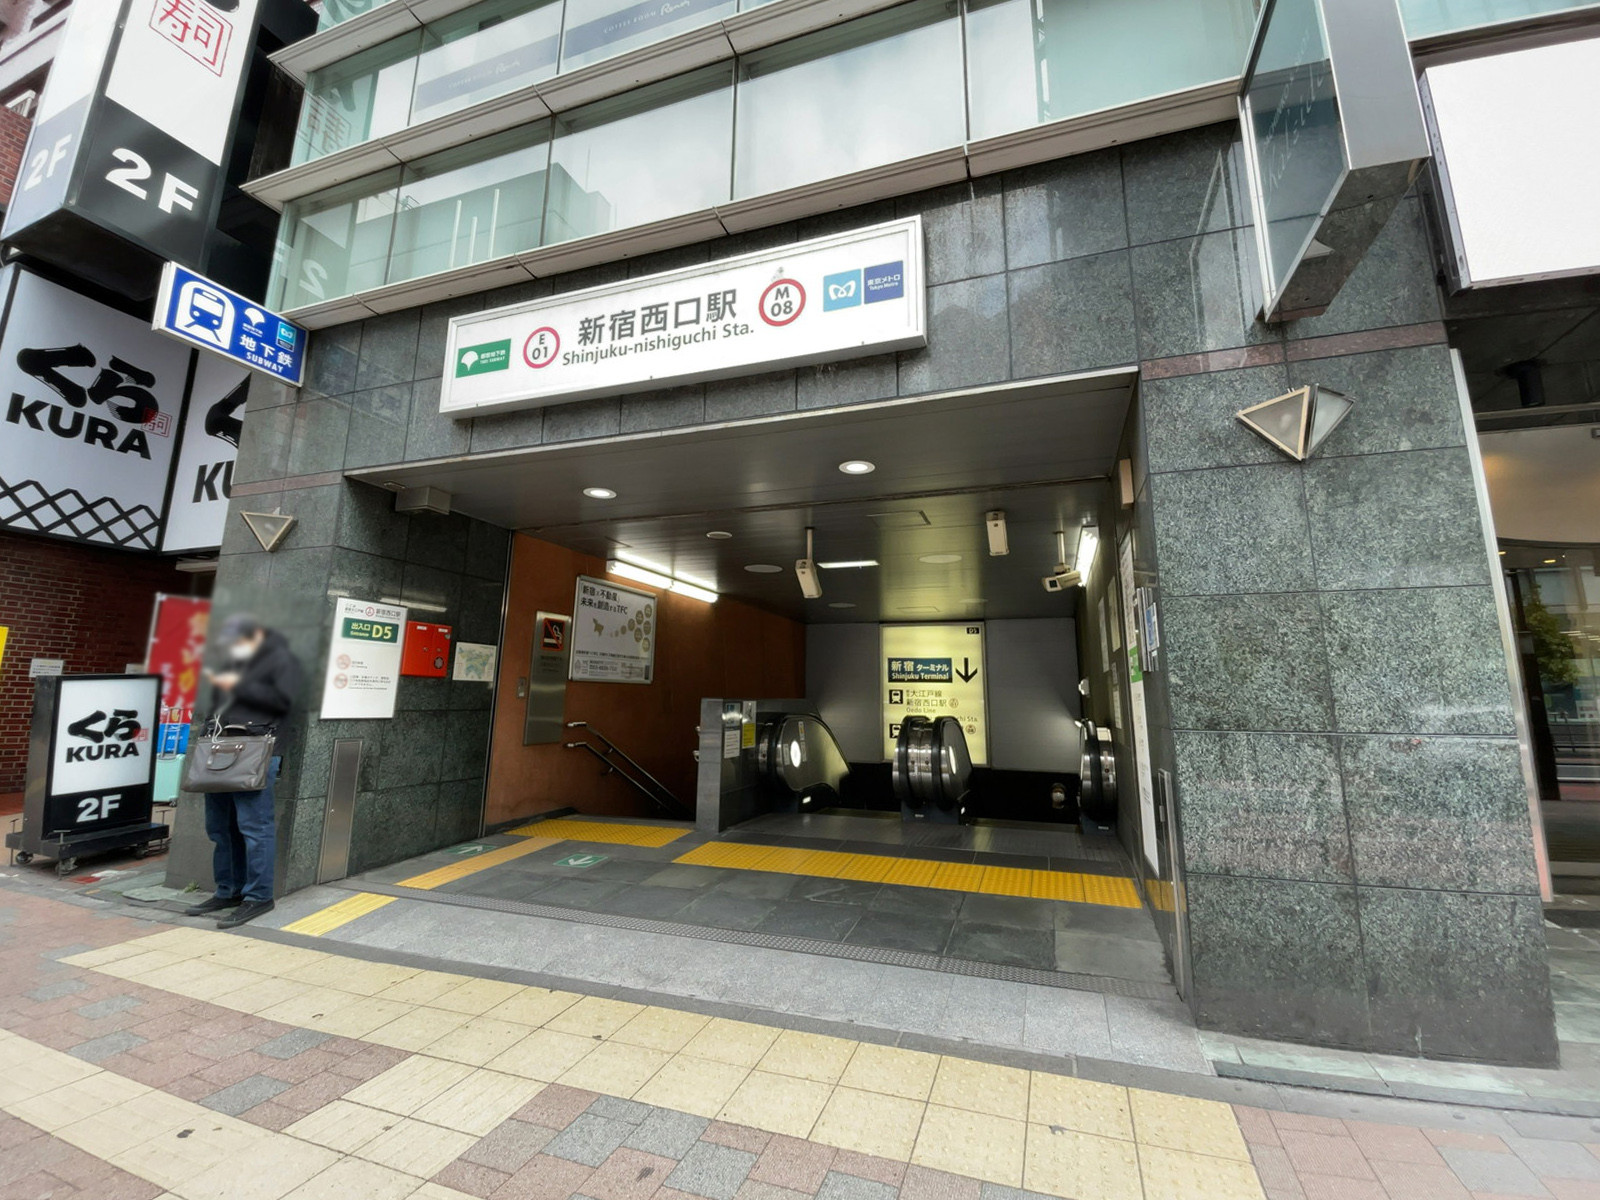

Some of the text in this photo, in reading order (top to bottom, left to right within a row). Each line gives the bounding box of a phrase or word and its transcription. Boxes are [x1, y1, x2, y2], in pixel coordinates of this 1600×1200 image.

[24, 134, 72, 192] 2F
[105, 147, 199, 214] 2F
[774, 286, 790, 301] M
[577, 288, 737, 346] 新宿西口駅
[770, 300, 793, 317] 08
[538, 333, 546, 345] E
[562, 321, 755, 366] Shinjuku-nishiguchi Sta.
[240, 334, 293, 368] 地下鉄
[531, 346, 548, 361] 01
[246, 352, 284, 373] SUBWAY
[17, 343, 160, 424] くら
[6, 393, 152, 460] KURA
[351, 622, 371, 631] 出入口
[372, 624, 393, 639] D5
[891, 672, 949, 681] Shinjuku Terminal
[906, 698, 947, 707] 新宿西口駅
[67, 709, 142, 744] くら
[66, 742, 140, 763] KURA
[76, 794, 122, 823] 2F
